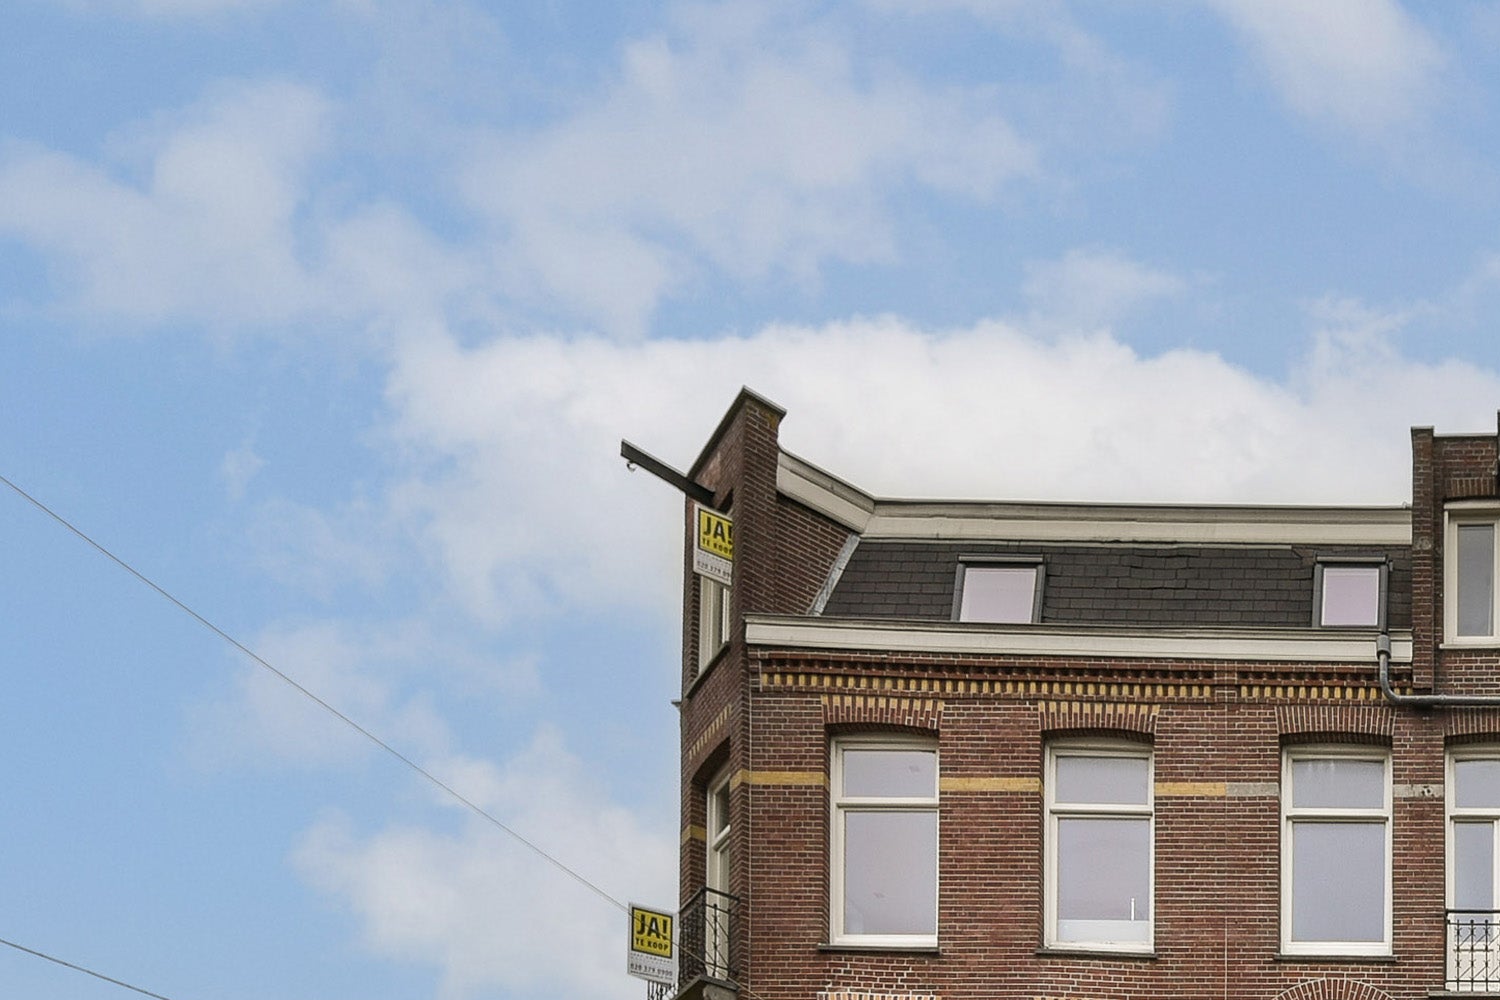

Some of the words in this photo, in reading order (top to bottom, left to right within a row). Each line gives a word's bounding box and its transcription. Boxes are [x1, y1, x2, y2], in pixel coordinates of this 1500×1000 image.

[636, 914, 668, 940] JA!
[635, 937, 644, 947] TE
[647, 941, 668, 951] KOOP
